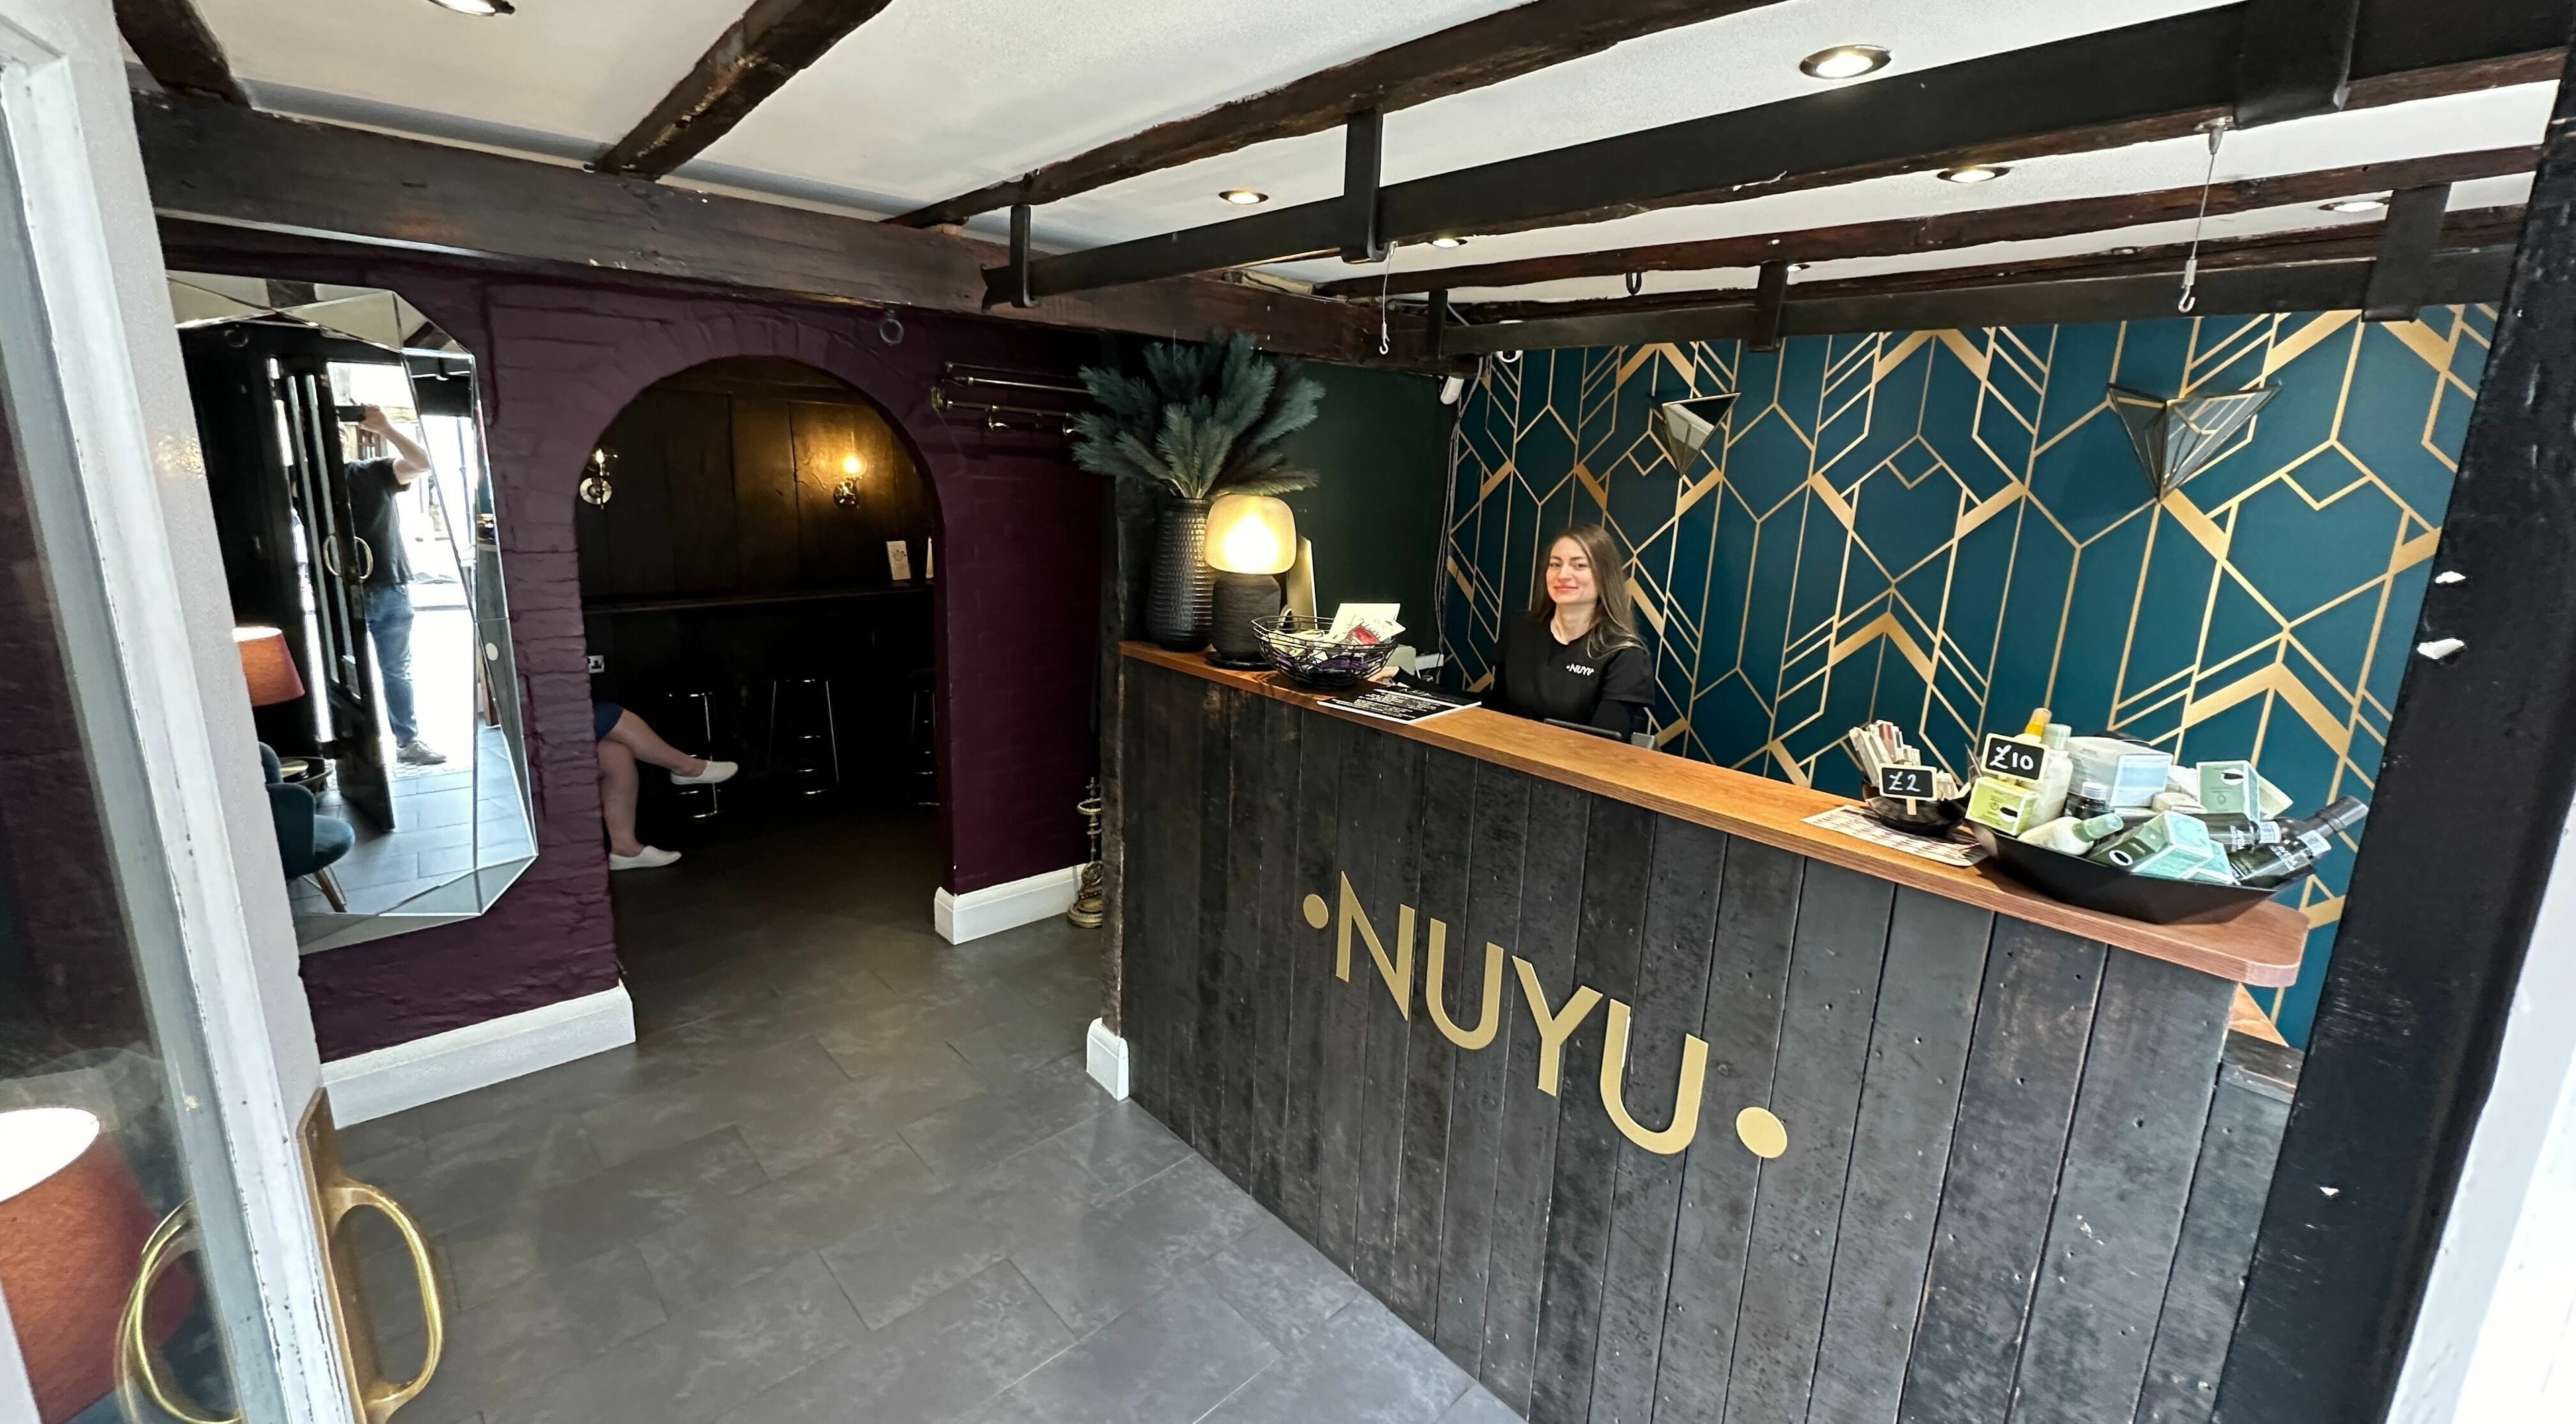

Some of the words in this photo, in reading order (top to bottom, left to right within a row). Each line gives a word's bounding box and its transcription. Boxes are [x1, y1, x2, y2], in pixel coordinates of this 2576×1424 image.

[1989, 744, 2034, 770] £10
[1888, 771, 1921, 792] £2
[1335, 871, 1709, 1155] NUYU
